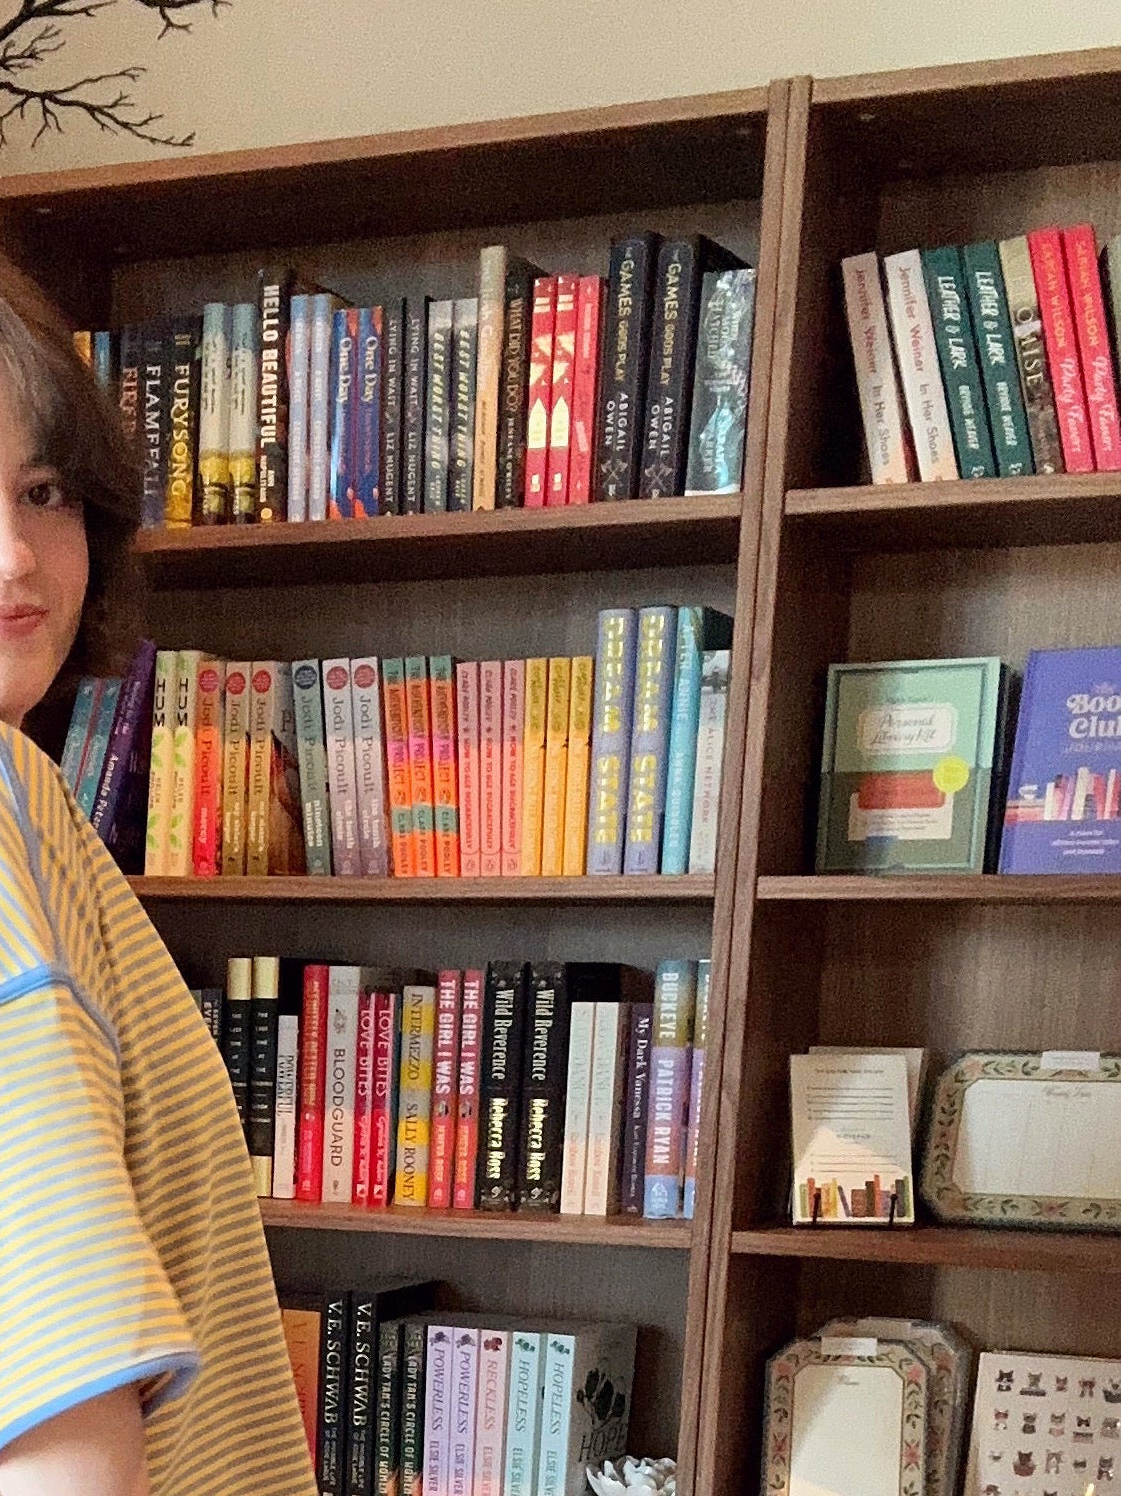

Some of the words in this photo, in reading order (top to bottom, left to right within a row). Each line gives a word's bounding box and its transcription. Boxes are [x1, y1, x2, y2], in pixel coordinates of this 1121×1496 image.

[618, 260, 634, 316] GAMES
[664, 263, 681, 320] GAMES
[938, 276, 961, 319] LEATHER
[975, 272, 998, 315] LEATHER
[262, 284, 280, 342] HELLO
[339, 337, 352, 370] One
[364, 337, 378, 369] One
[898, 267, 917, 318] Jennifer
[910, 327, 926, 372] Weiner
[923, 400, 935, 421] Her
[948, 338, 968, 369] LARK
[985, 334, 1005, 366] LARK
[387, 359, 396, 373] IN
[260, 349, 279, 448] BEAUTIFUL
[338, 374, 352, 402] Day
[361, 374, 377, 403] Day
[386, 377, 396, 406] WAIT
[872, 385, 884, 397] In
[169, 363, 192, 496] FURYSONG
[387, 432, 395, 448] LIZ
[605, 401, 615, 445] OWEN
[615, 392, 629, 451] ABIGAIL
[648, 405, 659, 449] OWEN
[660, 397, 674, 456] ABIGAIL
[963, 418, 978, 449] WEAVER
[457, 425, 469, 467] THING
[877, 429, 891, 465] Shoes
[385, 454, 395, 502] NUGENT
[330, 696, 345, 731] Jodi
[359, 694, 374, 729] Jodi
[335, 738, 349, 795] Picoult
[361, 736, 377, 794] Picoult
[631, 754, 658, 842] STATE
[701, 766, 714, 823] NETWORK
[438, 980, 455, 1009] THE
[463, 980, 479, 1009] THE
[495, 989, 515, 1016] Wild
[535, 989, 555, 1016] Wild
[658, 972, 679, 1039] BUCKEYE
[360, 1009, 372, 1048] LOVE
[378, 1009, 392, 1049] LOVE
[407, 993, 424, 1081] INTERMEZZO
[437, 1013, 454, 1048] GIRL
[461, 1013, 478, 1048] GIRL
[635, 1017, 650, 1035] My
[491, 1020, 513, 1080] Reverence
[531, 1020, 553, 1081] Reverence
[635, 1040, 649, 1069] Dark
[376, 1057, 390, 1097] BITES
[435, 1061, 451, 1095] WAS
[459, 1061, 475, 1095] WAS
[633, 1073, 646, 1119] Vanessa
[654, 1059, 674, 1121] PATRICK
[330, 1048, 346, 1167] BLOODGUARD
[404, 1103, 419, 1144] SALLY
[527, 1099, 549, 1149] Rebecca
[486, 1151, 506, 1179] Ross
[652, 1126, 672, 1165] RYAN
[402, 1147, 416, 1202] ROONEY
[327, 1317, 342, 1336] E.
[328, 1299, 343, 1314] V.
[323, 1338, 341, 1424] SCHWAB
[353, 1340, 370, 1427] SCHWAB
[381, 1355, 393, 1380] LADY
[431, 1347, 446, 1431] POWERLESS
[456, 1350, 471, 1435] POWERLESS
[484, 1360, 498, 1431] RECKLESS
[514, 1359, 530, 1433] HOPELESS
[549, 1362, 565, 1435] HOPELESS
[381, 1411, 392, 1445] CIRCLE
[381, 1446, 391, 1459] OF
[429, 1440, 441, 1463] ELSIE
[379, 1461, 391, 1494] WOMEN
[428, 1464, 440, 1491] SILVER
